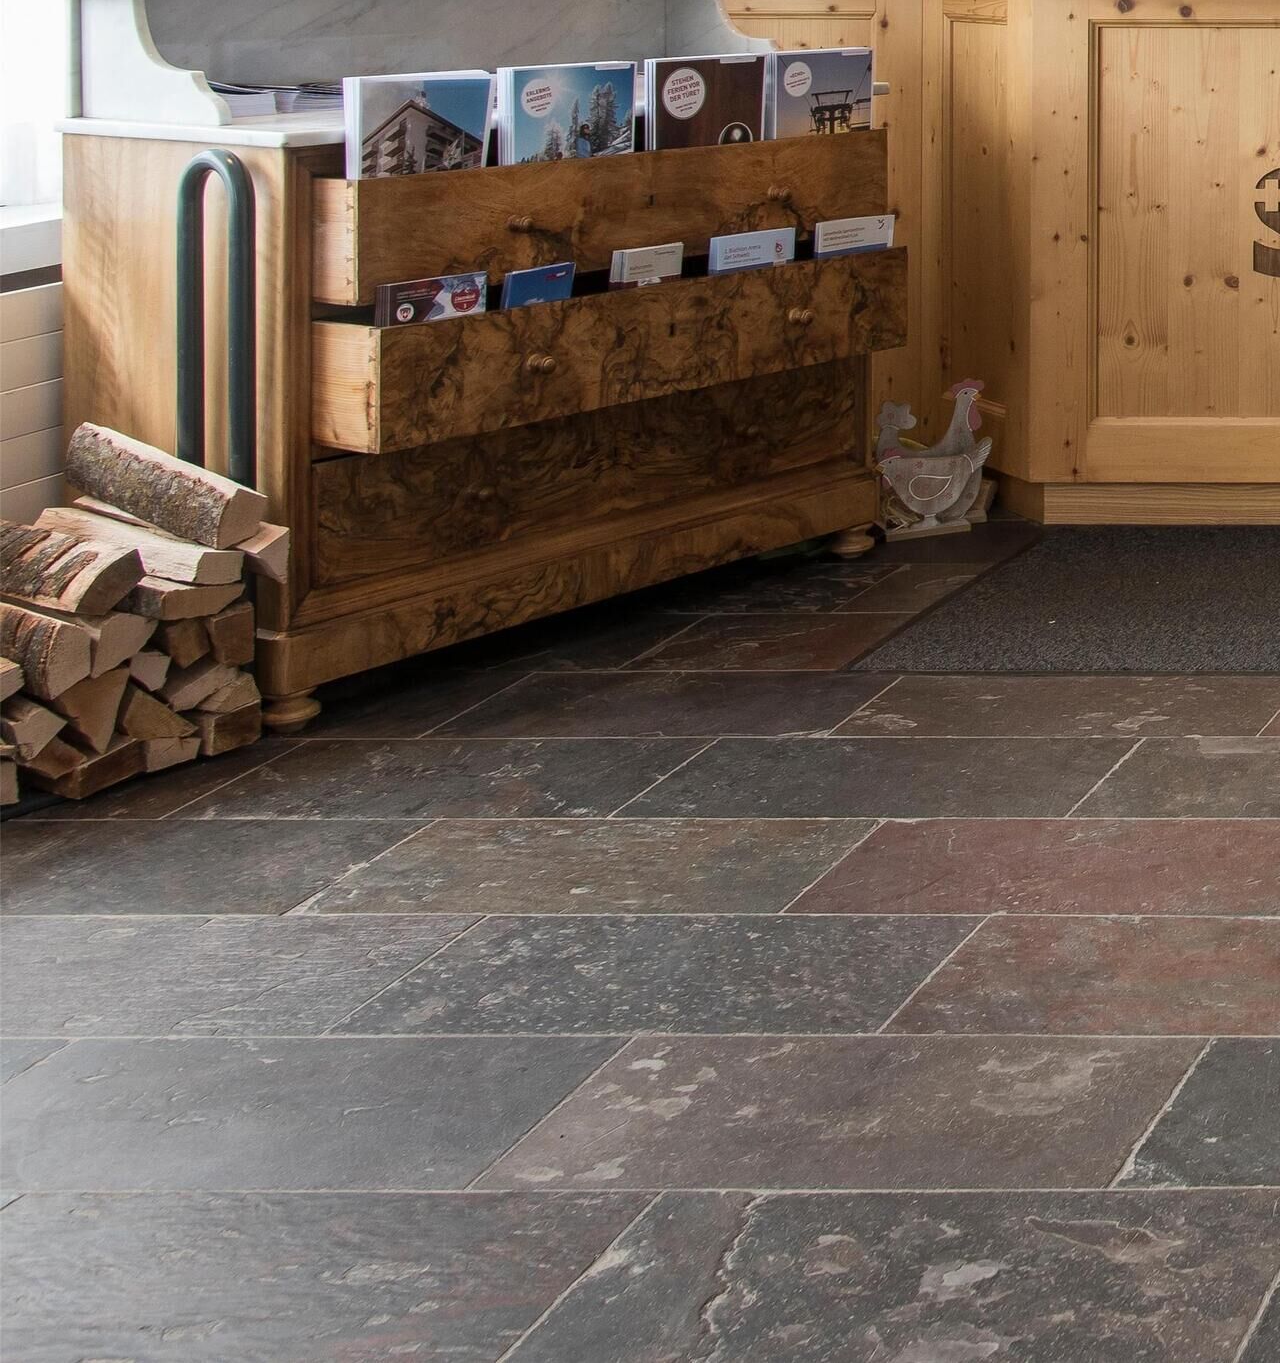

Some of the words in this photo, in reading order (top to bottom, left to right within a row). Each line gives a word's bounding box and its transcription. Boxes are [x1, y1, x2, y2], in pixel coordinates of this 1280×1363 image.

[671, 74, 694, 86] STEHEN
[667, 84, 688, 95] FERIEN
[670, 93, 682, 102] DER
